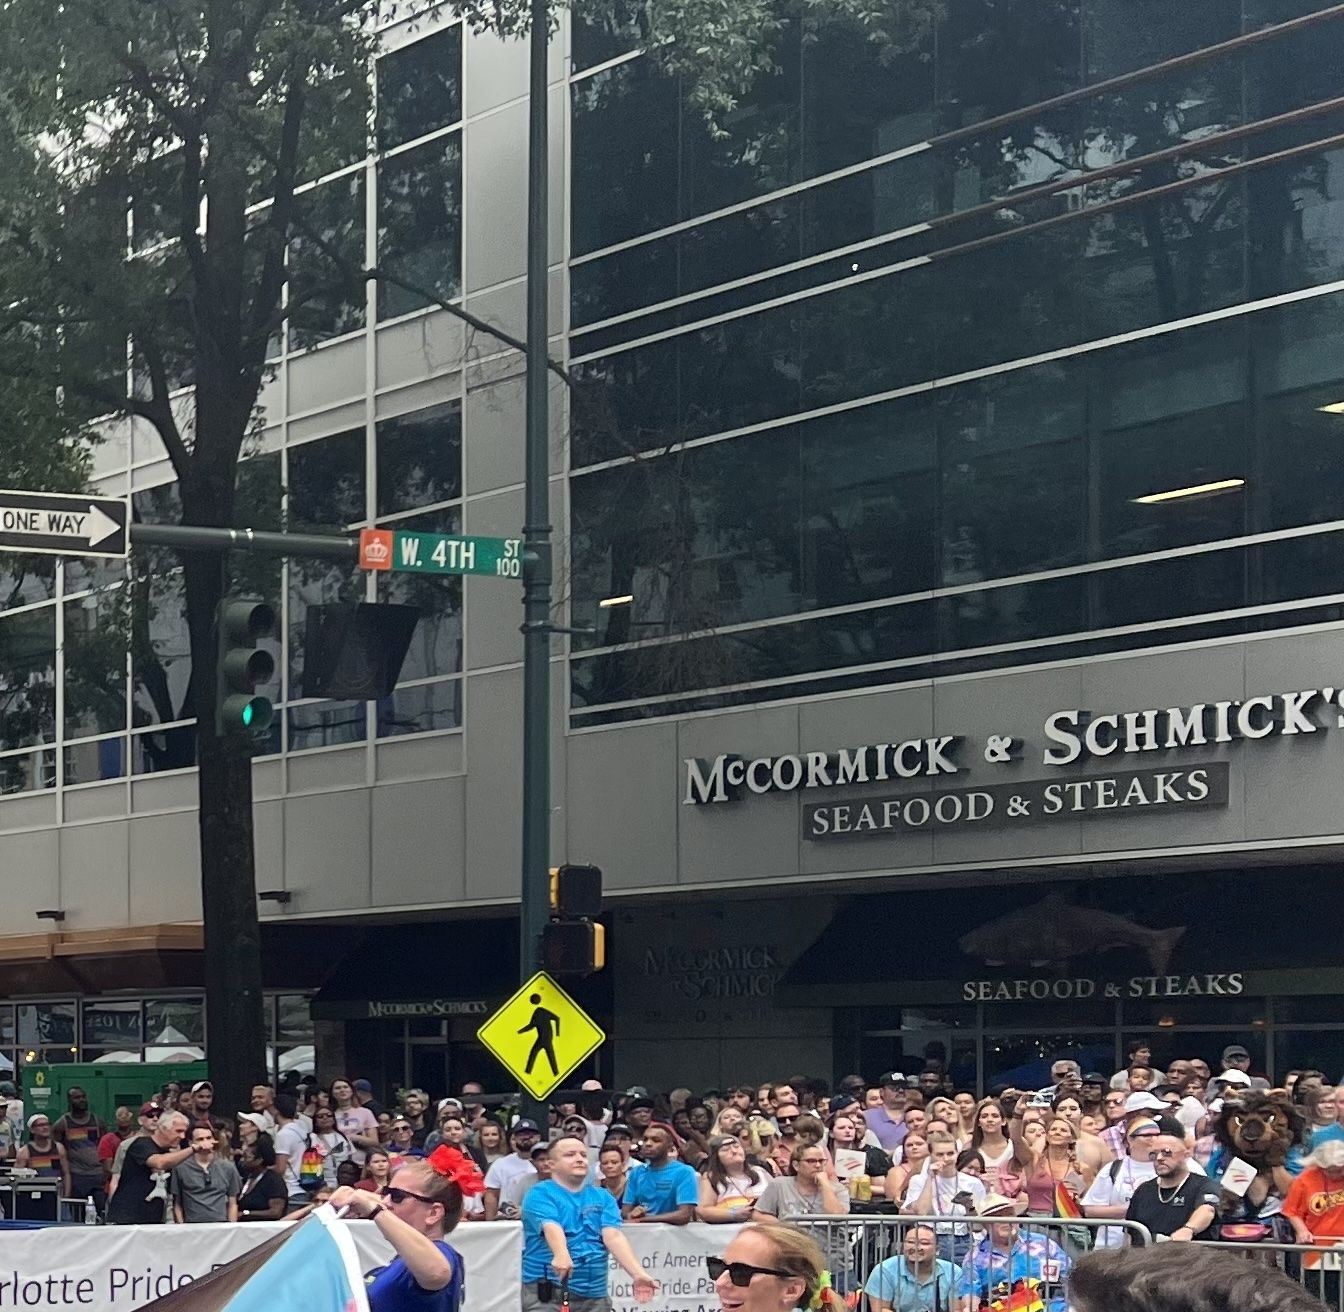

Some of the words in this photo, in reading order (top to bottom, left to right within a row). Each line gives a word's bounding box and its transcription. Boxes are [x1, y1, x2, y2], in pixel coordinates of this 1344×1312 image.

[3, 511, 40, 531] ONE
[48, 513, 86, 534] WAY
[401, 537, 423, 567] W.
[431, 539, 476, 570] 4TH
[504, 539, 521, 558] ST
[496, 558, 521, 577] 100
[985, 735, 1013, 764] &
[812, 792, 995, 836] SEAFOOD
[1007, 795, 1032, 817] &
[1043, 769, 1210, 815] STEAKS
[963, 978, 1095, 1002] SEAFOOD
[1104, 981, 1121, 998] &
[1128, 972, 1244, 998] STEAKS
[663, 1251, 717, 1268] Amer
